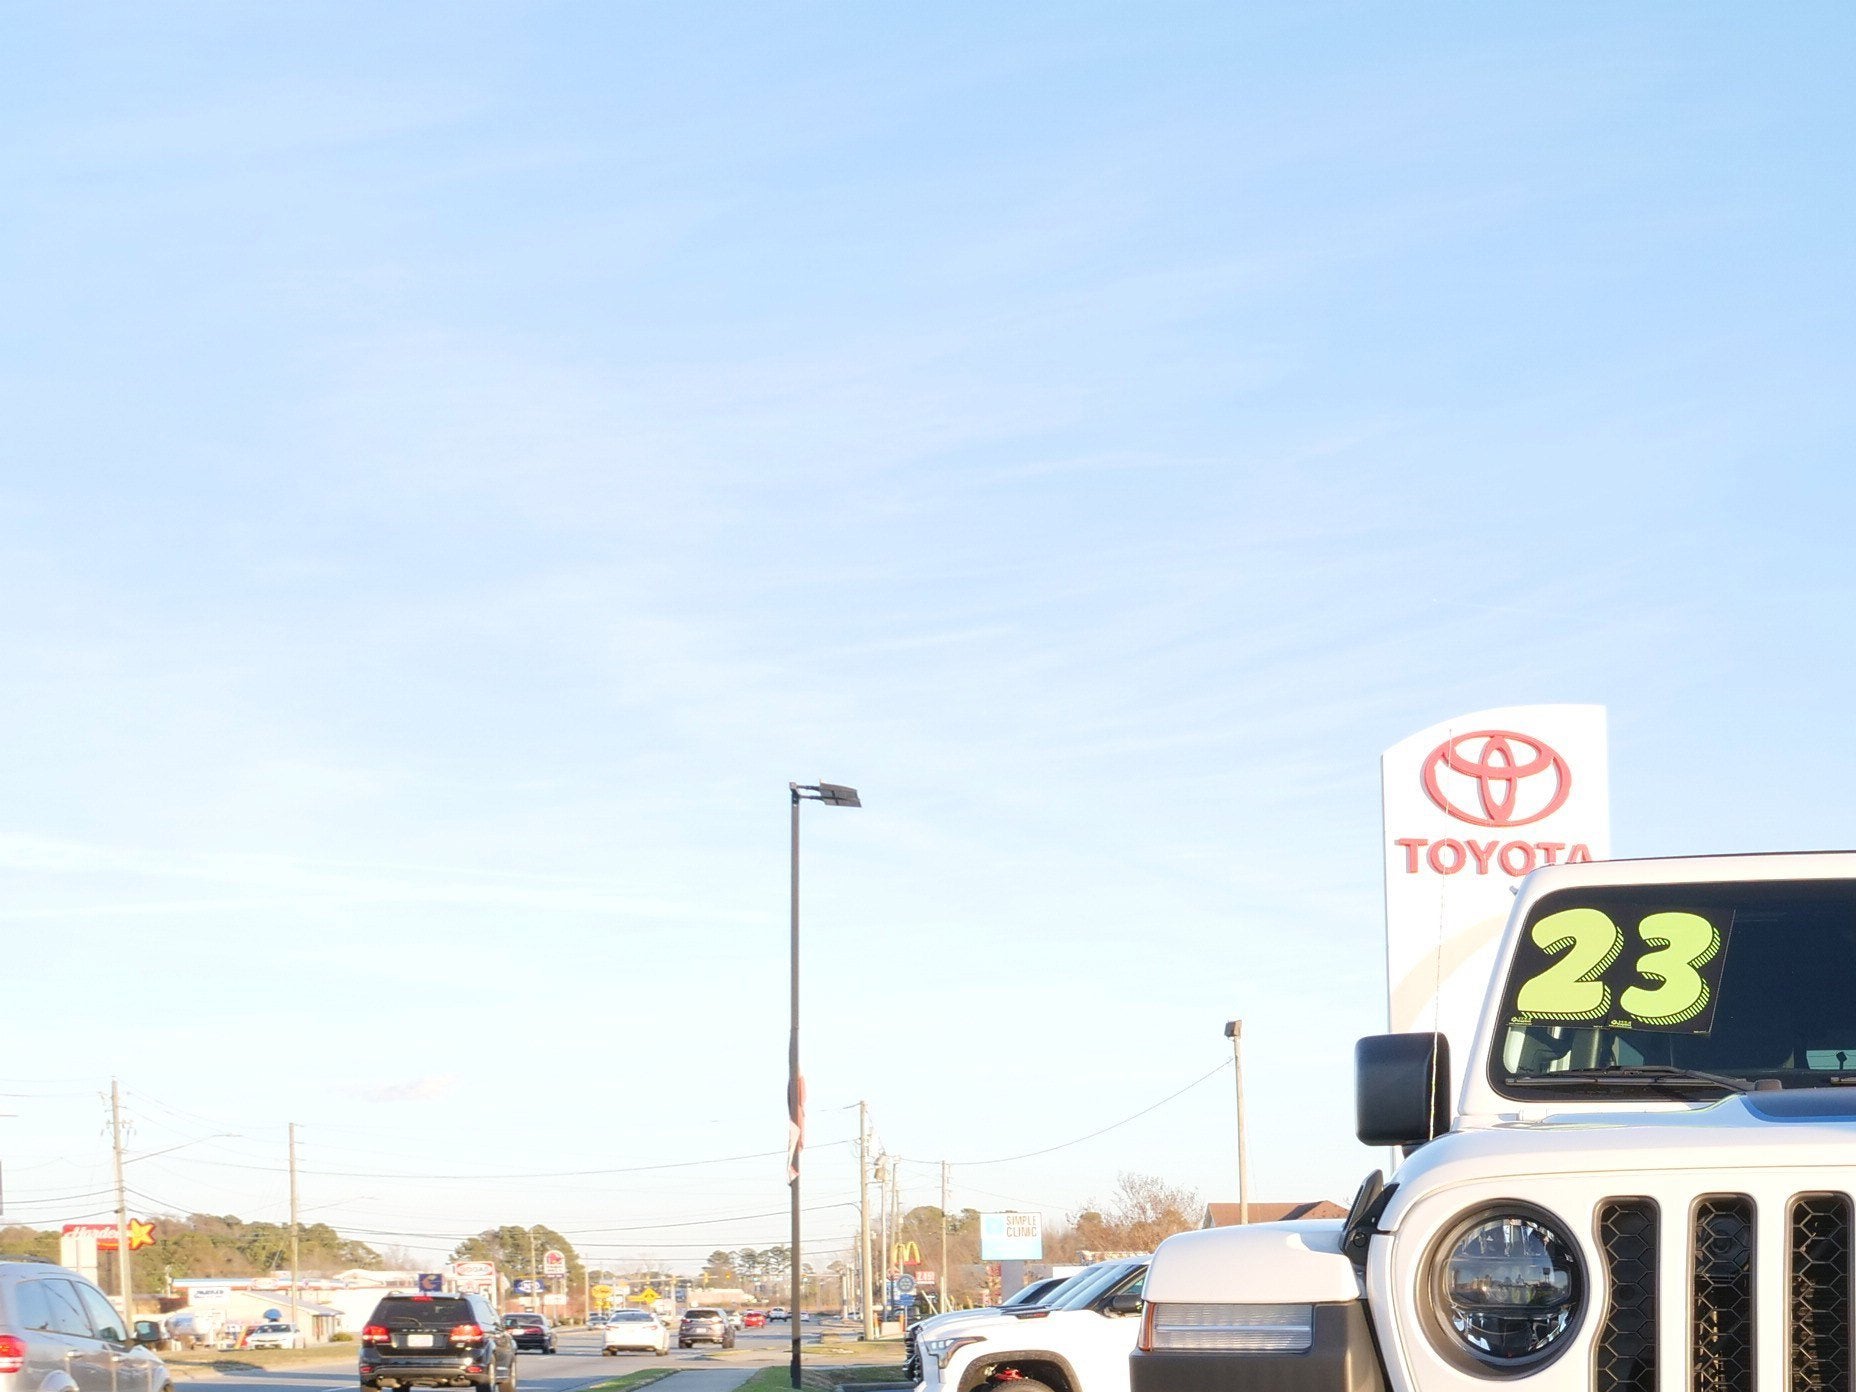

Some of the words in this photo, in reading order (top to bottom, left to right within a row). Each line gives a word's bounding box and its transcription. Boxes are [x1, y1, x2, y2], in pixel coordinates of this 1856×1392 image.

[1395, 838, 1592, 877] TOYOTA
[1517, 908, 1721, 1025] 23
[1006, 1215, 1037, 1226] SIMPLE
[1006, 1226, 1037, 1237] CLINIC
